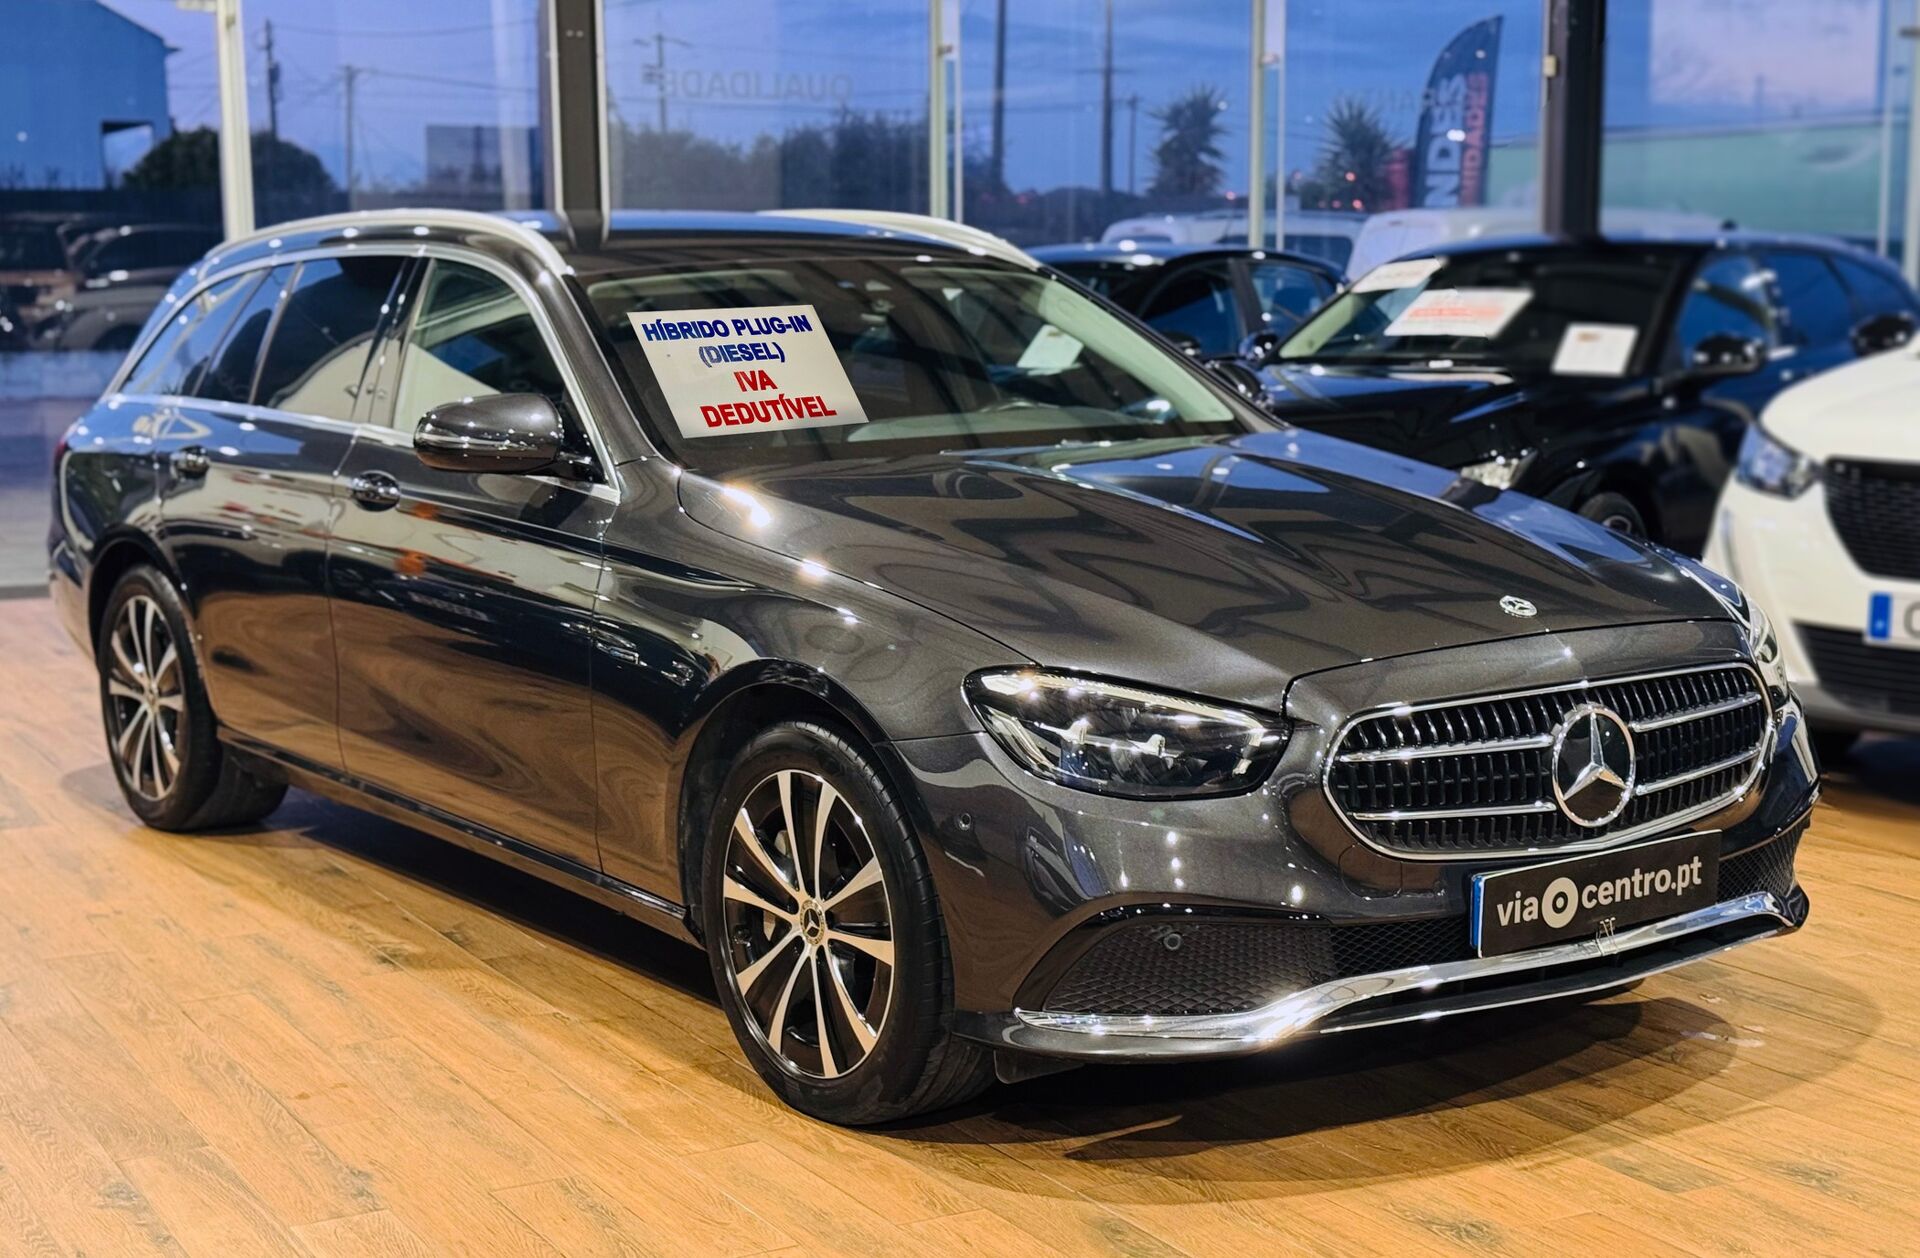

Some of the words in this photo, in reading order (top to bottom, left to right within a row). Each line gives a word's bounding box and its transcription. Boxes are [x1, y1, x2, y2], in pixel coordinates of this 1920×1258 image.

[641, 319, 730, 342] HÍBRIDO
[731, 314, 813, 336] PLUG-IN
[698, 342, 786, 368] (DIESEL)
[733, 369, 778, 392] IVA
[699, 393, 838, 428] DEDUTÍVEL
[1581, 855, 1702, 909] centro.pt
